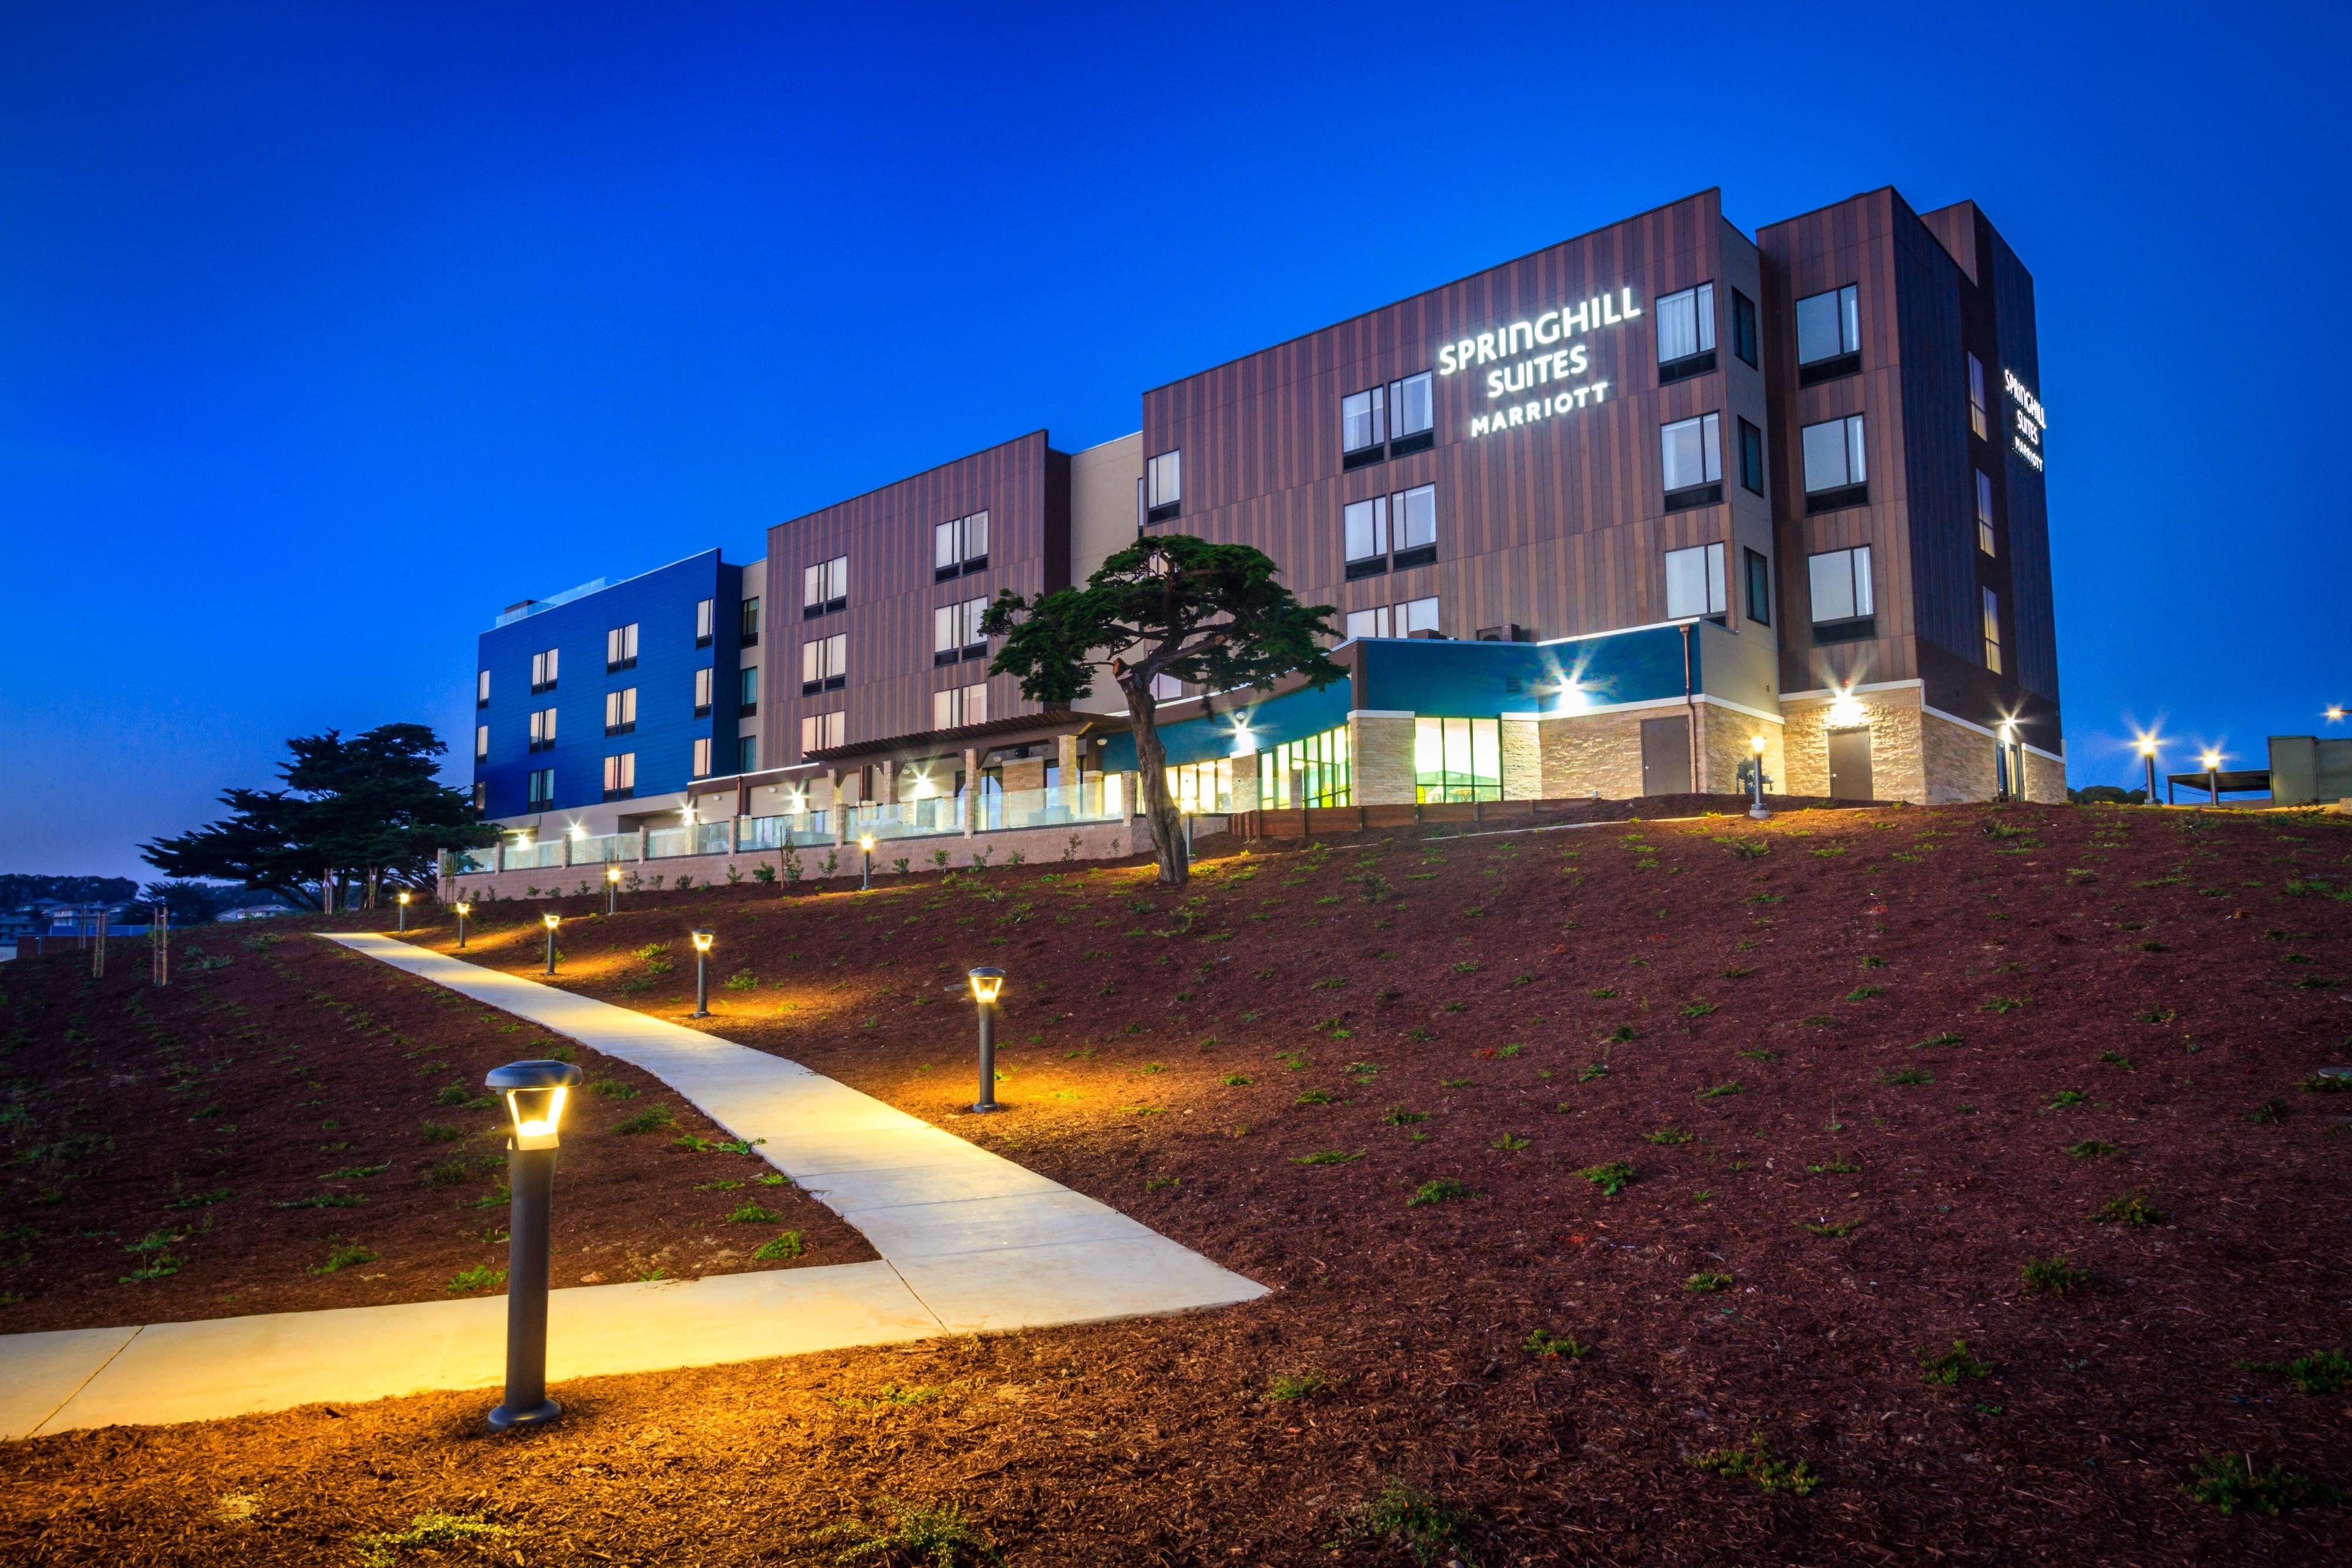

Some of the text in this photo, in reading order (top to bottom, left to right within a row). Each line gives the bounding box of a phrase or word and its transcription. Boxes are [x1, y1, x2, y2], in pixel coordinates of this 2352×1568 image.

[1439, 287, 1641, 375] SPRINGHILL
[1487, 344, 1588, 398] SUITES
[1471, 382, 1608, 438] MARRIOTT
[2018, 410, 2038, 445] SUITES
